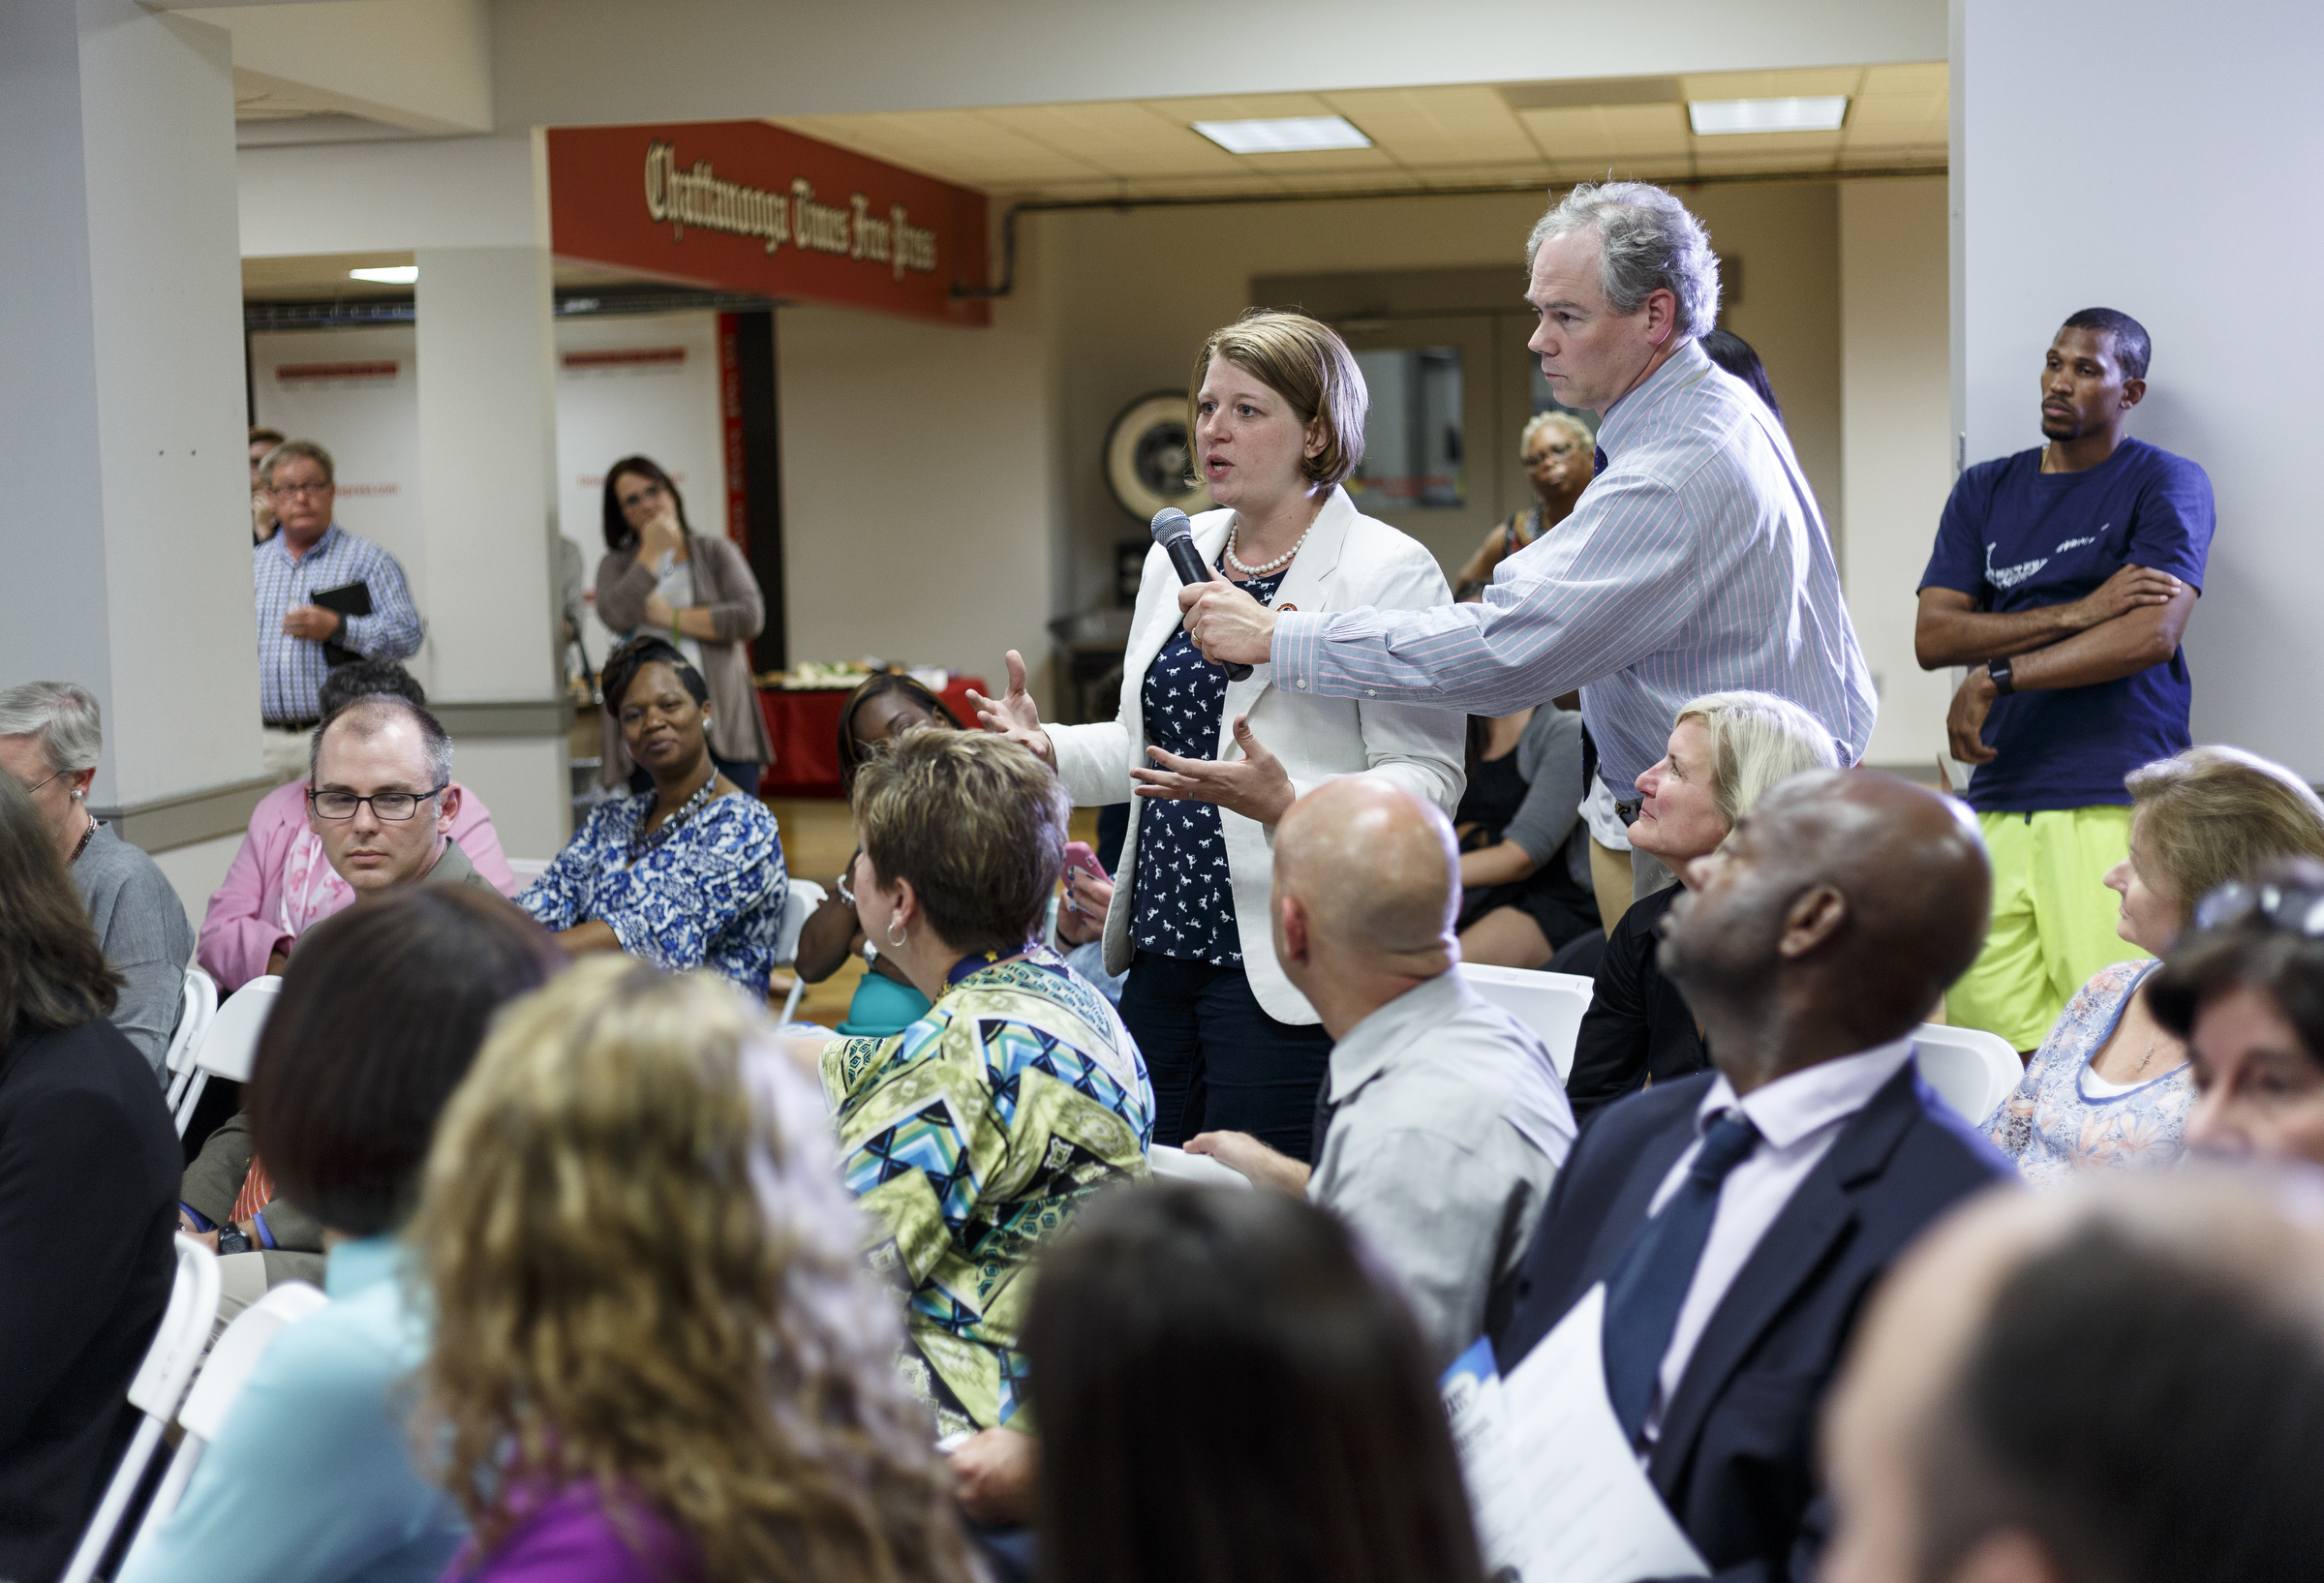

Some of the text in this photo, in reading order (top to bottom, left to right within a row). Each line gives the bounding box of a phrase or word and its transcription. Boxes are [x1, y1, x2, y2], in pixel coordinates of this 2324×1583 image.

[646, 139, 936, 281] Chattanooga Times Free Press
